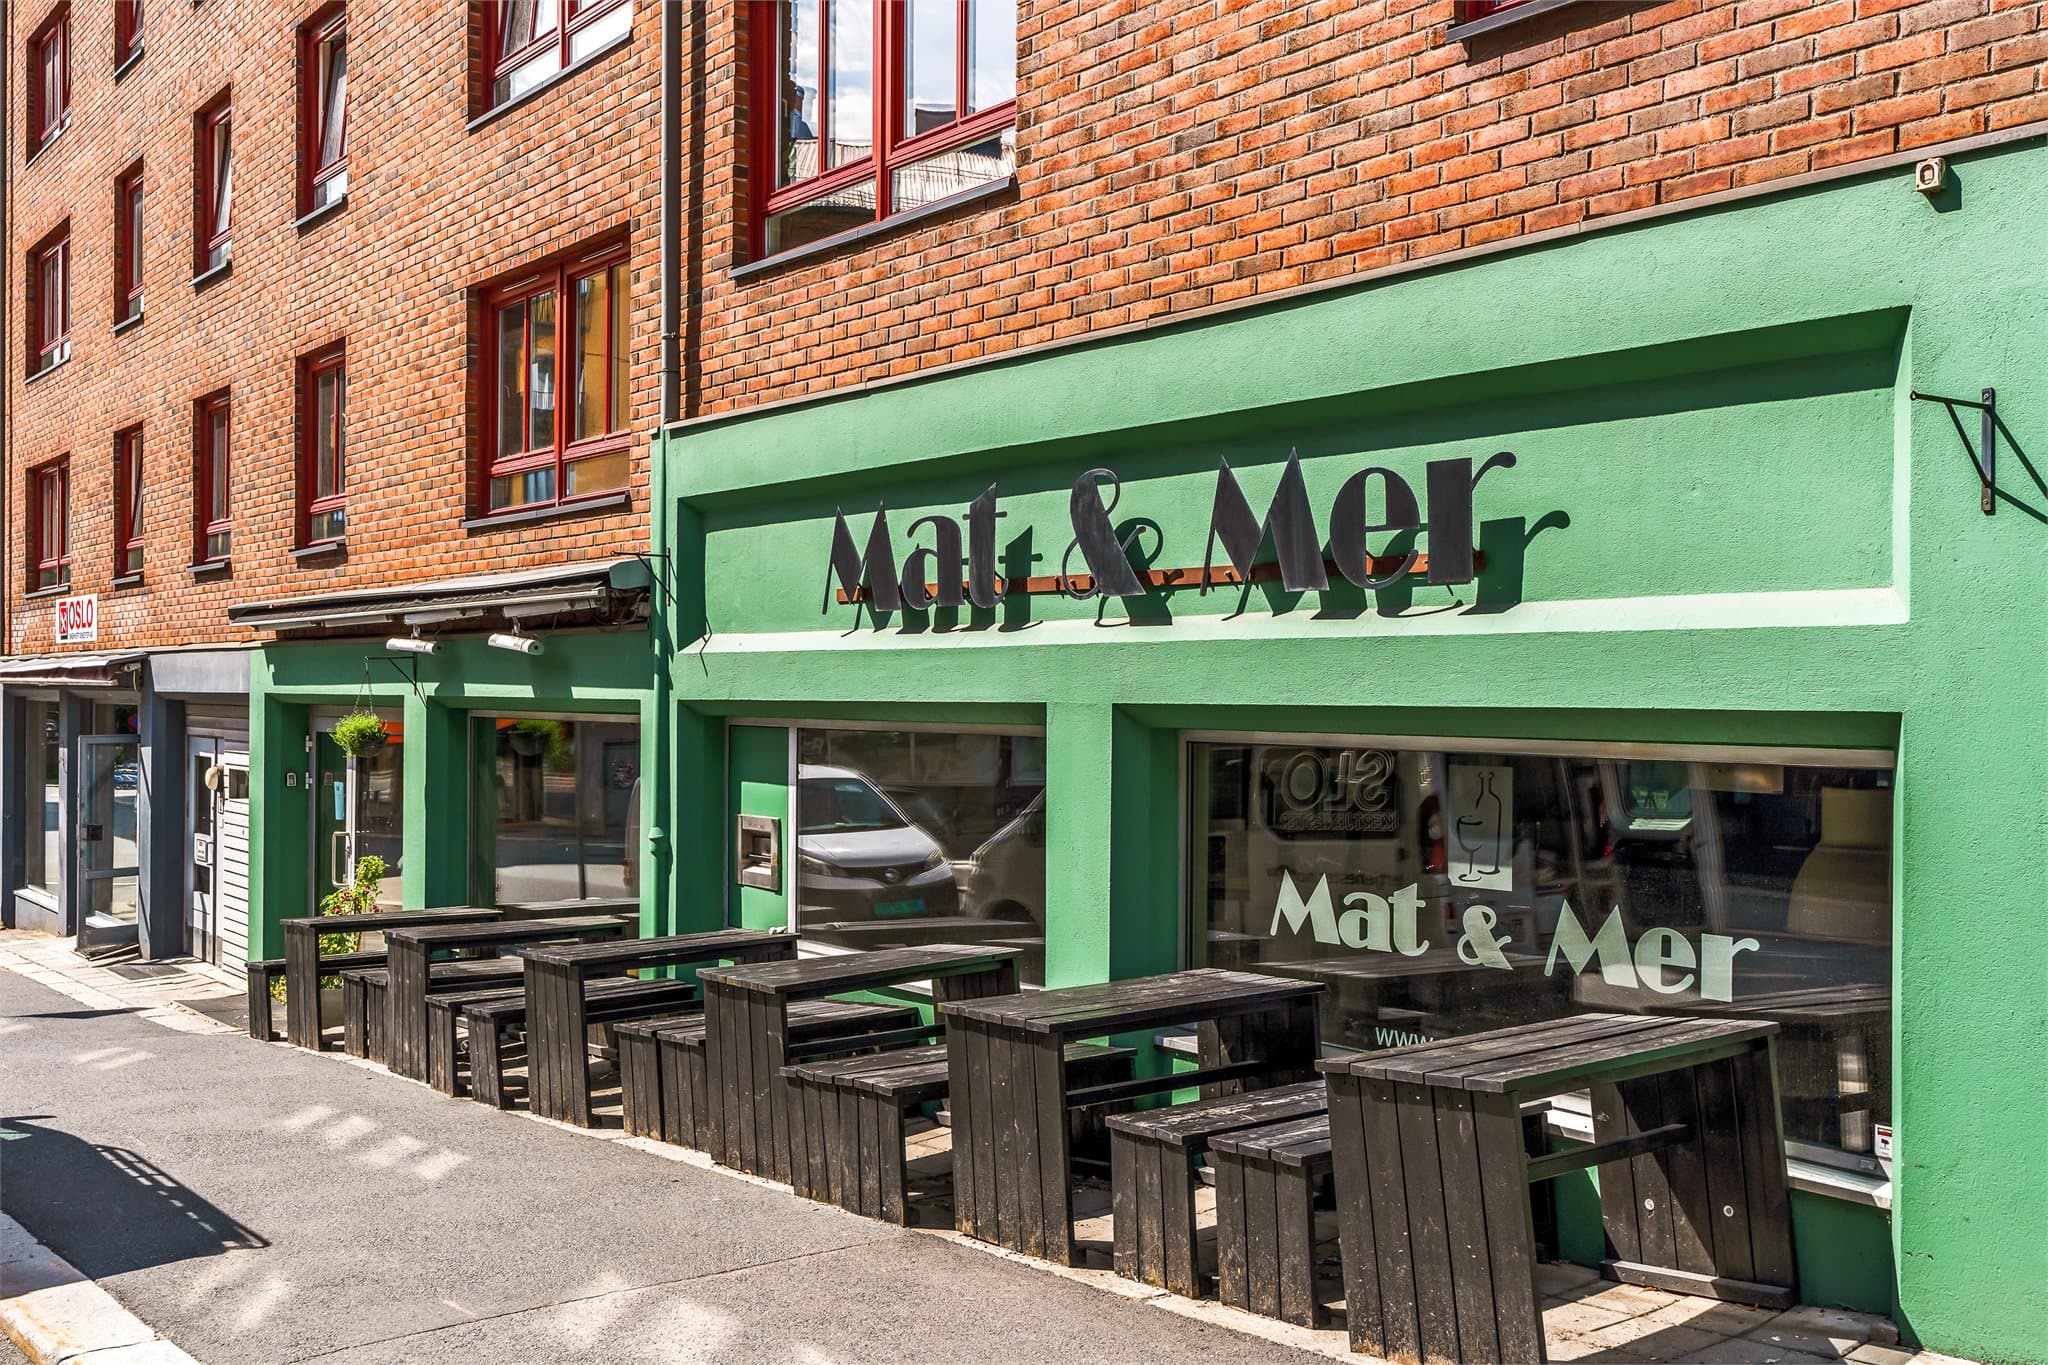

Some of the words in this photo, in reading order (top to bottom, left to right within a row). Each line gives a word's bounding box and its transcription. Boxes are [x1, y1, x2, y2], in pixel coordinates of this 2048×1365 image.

[822, 481, 1009, 616] Mat
[1062, 467, 1147, 600] &
[1200, 446, 1517, 597] Mer
[69, 598, 94, 630] OSLO
[1269, 868, 1430, 957] Mat
[1457, 904, 1513, 971] &
[1543, 899, 1760, 1003] Mer
